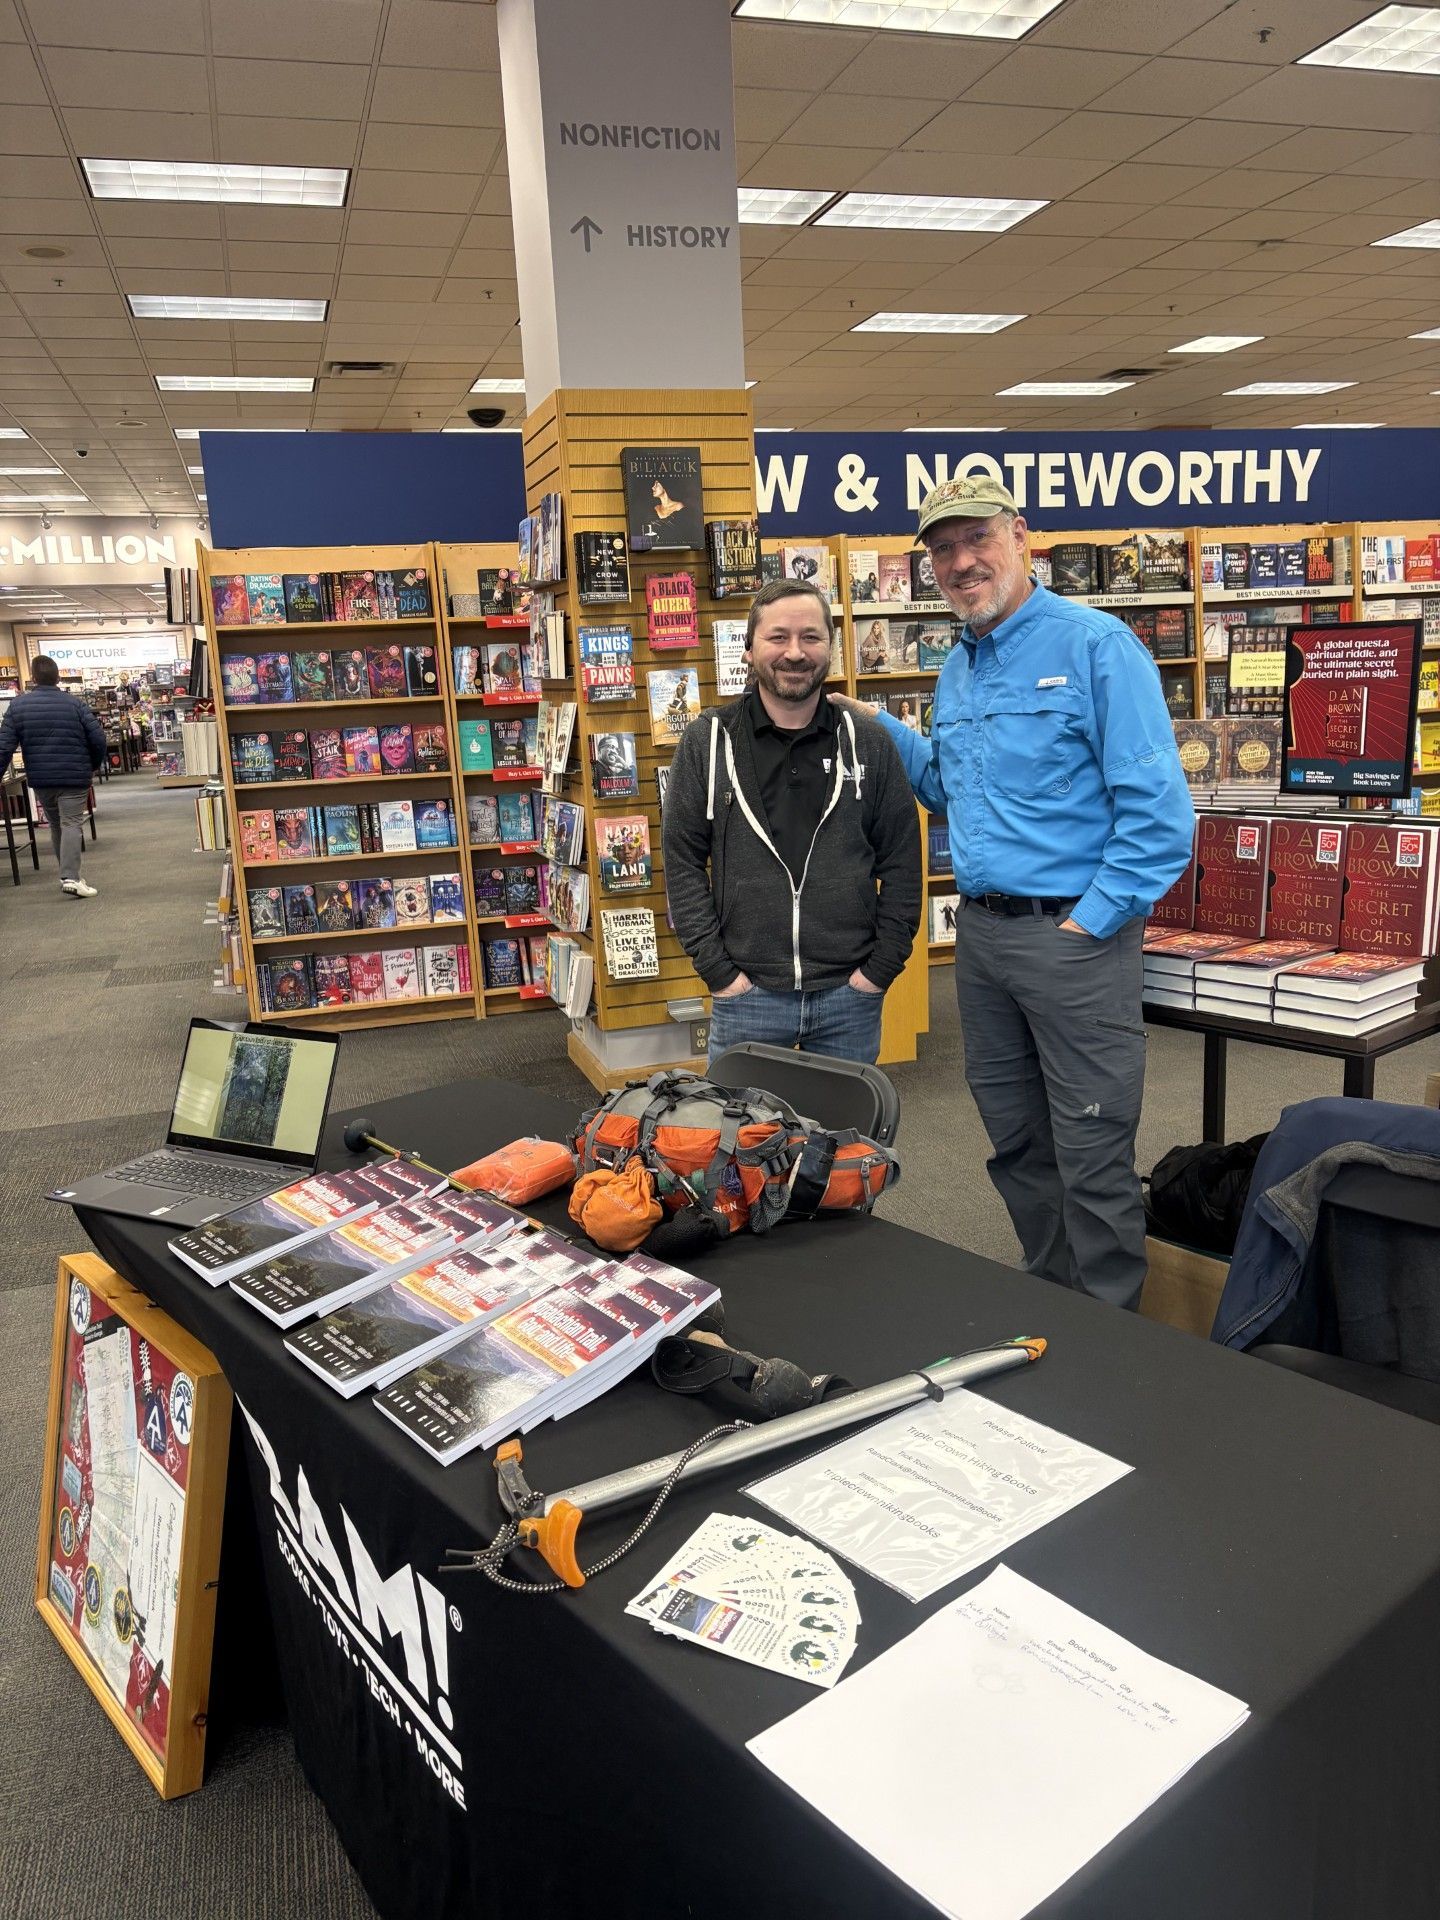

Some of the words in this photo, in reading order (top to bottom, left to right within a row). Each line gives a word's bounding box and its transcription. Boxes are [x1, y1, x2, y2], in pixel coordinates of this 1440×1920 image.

[560, 123, 721, 151] NONFICTION
[627, 225, 730, 248] HISTORY
[834, 453, 879, 512] &
[715, 532, 744, 549] BLACK
[1308, 539, 1328, 548] JELANI
[1362, 537, 1377, 552] THE
[717, 548, 757, 566] HISTORY
[1308, 547, 1325, 556] COBB
[1308, 563, 1317, 571] OR
[1317, 562, 1333, 571] MORE
[1387, 557, 1405, 565] FIRST
[1418, 559, 1433, 567] LEAD
[658, 581, 690, 596] BLACK
[350, 599, 371, 608] FIRE
[400, 597, 427, 612] DEAD
[653, 597, 693, 614] QUEER
[1114, 596, 1142, 604] HISTORY
[654, 613, 692, 627] HISTORY
[1220, 613, 1245, 623] MAHA
[588, 636, 630, 653] KINGS
[1314, 641, 1322, 649] A
[1323, 640, 1353, 651] global
[49, 650, 73, 660] POP
[76, 648, 127, 658] CULTURE
[1305, 651, 1343, 660] spiritual
[1345, 650, 1377, 659] riddle,
[1379, 648, 1398, 657] and
[1307, 660, 1322, 669] the
[1324, 660, 1362, 669] ultimate
[1364, 659, 1394, 668] secret
[590, 668, 632, 685] PAWNS
[1302, 670, 1333, 679] buried
[1335, 669, 1344, 678] in
[1346, 669, 1370, 680] plain
[1371, 668, 1399, 679] sight.
[1329, 688, 1362, 702] DAN
[1328, 703, 1361, 714] BROWN
[498, 731, 507, 739] OF
[507, 730, 520, 738] HIM
[1330, 725, 1358, 734] SECRET
[280, 745, 300, 754] WERE
[1328, 740, 1358, 750] SECRETS
[317, 746, 339, 758] STAIR
[1240, 837, 1255, 845] 50%
[1321, 840, 1336, 849] 50%
[1401, 842, 1419, 852] 50%
[1240, 848, 1253, 856] 30%
[1319, 852, 1334, 860] 30%
[1400, 855, 1417, 864] 30%
[612, 862, 646, 877] LAND
[1221, 875, 1237, 884] THE
[1296, 882, 1313, 890] THE
[1205, 884, 1256, 901] SECRET
[1370, 890, 1389, 898] THE
[1277, 891, 1334, 909] SECRET
[1296, 909, 1308, 917] OF
[1350, 899, 1413, 917] SECRET
[612, 912, 652, 922] HARRIET
[1201, 909, 1256, 928] SECRETS
[1371, 918, 1384, 926] OF
[1272, 918, 1333, 937] SECRETS
[615, 937, 639, 946] LIVE
[1345, 926, 1412, 946] SECRETS
[616, 943, 656, 952] CONCERT
[618, 963, 638, 971] BOB
[641, 961, 657, 969] THE
[358, 981, 378, 989] GIRLS
[647, 1299, 671, 1317] Trail
[534, 1329, 557, 1348] and
[550, 1340, 576, 1359] Life
[576, 1328, 608, 1353] Trail,
[983, 1419, 1016, 1440] Please
[907, 1425, 934, 1442] Triple
[934, 1440, 967, 1460] Crown
[967, 1457, 1002, 1479] Hiking
[1001, 1473, 1037, 1496] Books
[823, 1468, 941, 1539] triplecrownhikingbooks
[993, 1606, 1011, 1620] Name
[1046, 1639, 1066, 1653] Email
[1119, 1683, 1133, 1694] City
[1152, 1702, 1171, 1715] State
[1068, 1639, 1088, 1655] Book
[1088, 1651, 1117, 1672] Signing
[276, 1528, 311, 1600] BOOKS
[318, 1603, 351, 1660] TOYS
[360, 1658, 402, 1729] TECH
[413, 1726, 467, 1811] MORE
